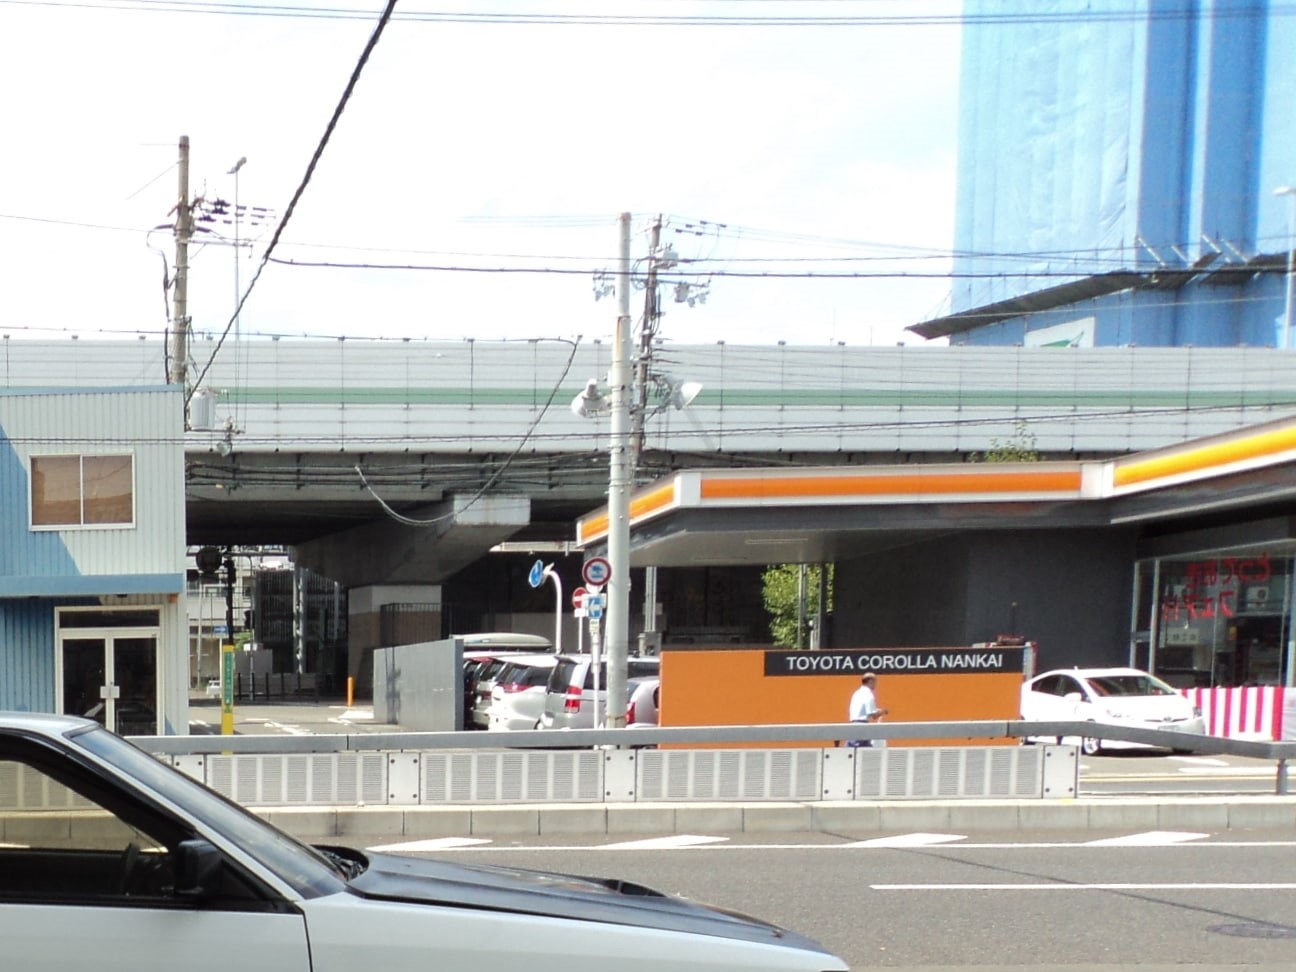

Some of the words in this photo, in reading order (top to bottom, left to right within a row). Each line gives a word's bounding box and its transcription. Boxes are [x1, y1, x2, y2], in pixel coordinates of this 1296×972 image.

[786, 656, 855, 670] TOYOTA
[858, 654, 938, 670] COROLLA
[941, 653, 1003, 669] NANKAI
